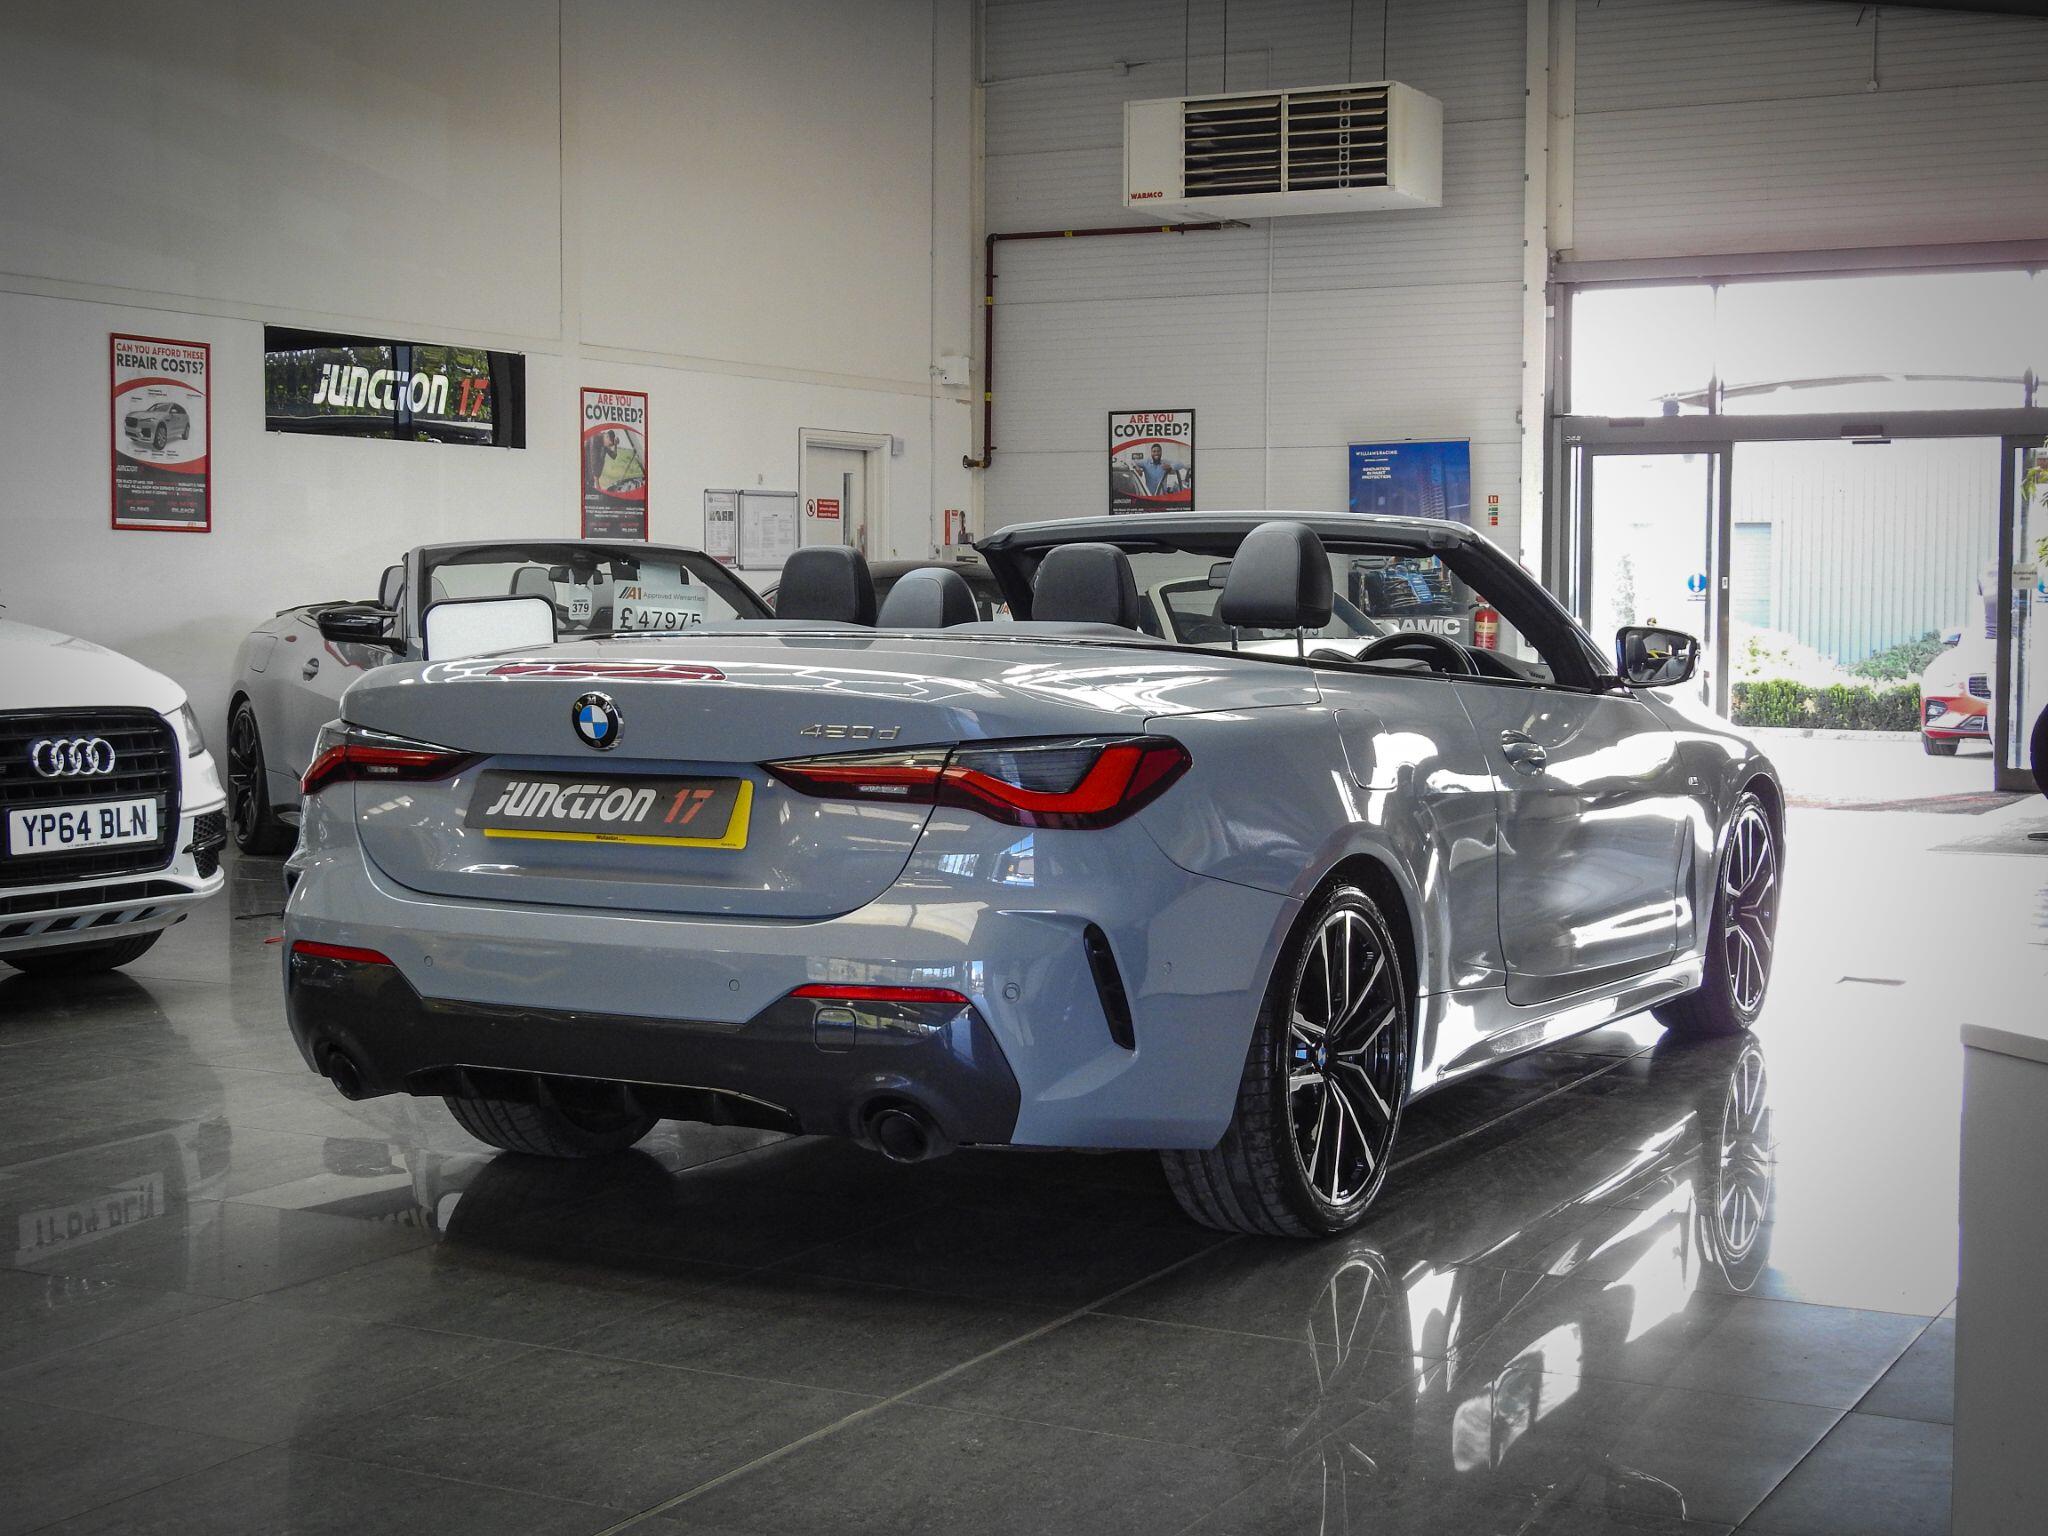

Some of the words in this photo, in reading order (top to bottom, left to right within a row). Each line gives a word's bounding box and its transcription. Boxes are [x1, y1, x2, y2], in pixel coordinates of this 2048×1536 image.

[1131, 191, 1163, 199] WARMCO
[116, 343, 132, 352] CAN
[135, 345, 149, 354] YOU
[152, 348, 181, 357] AFFORD
[183, 350, 204, 360] THESE
[117, 353, 157, 370] REPAIR
[161, 358, 204, 374] COSTS?
[312, 363, 449, 415] JUNCTION
[459, 378, 489, 416] 17
[598, 394, 613, 405] ARE
[616, 395, 632, 406] YOU
[585, 404, 643, 423] COVERED?
[1130, 415, 1149, 423] ARE
[1153, 414, 1174, 423] YOU
[1114, 423, 1190, 437] COVERED?
[643, 592, 672, 600] Approved
[572, 603, 589, 612] 379
[575, 695, 613, 714] BMW
[486, 781, 657, 823] JUNCTION
[664, 788, 715, 824] 17
[22, 810, 92, 847] YP64
[99, 805, 147, 839] BLN
